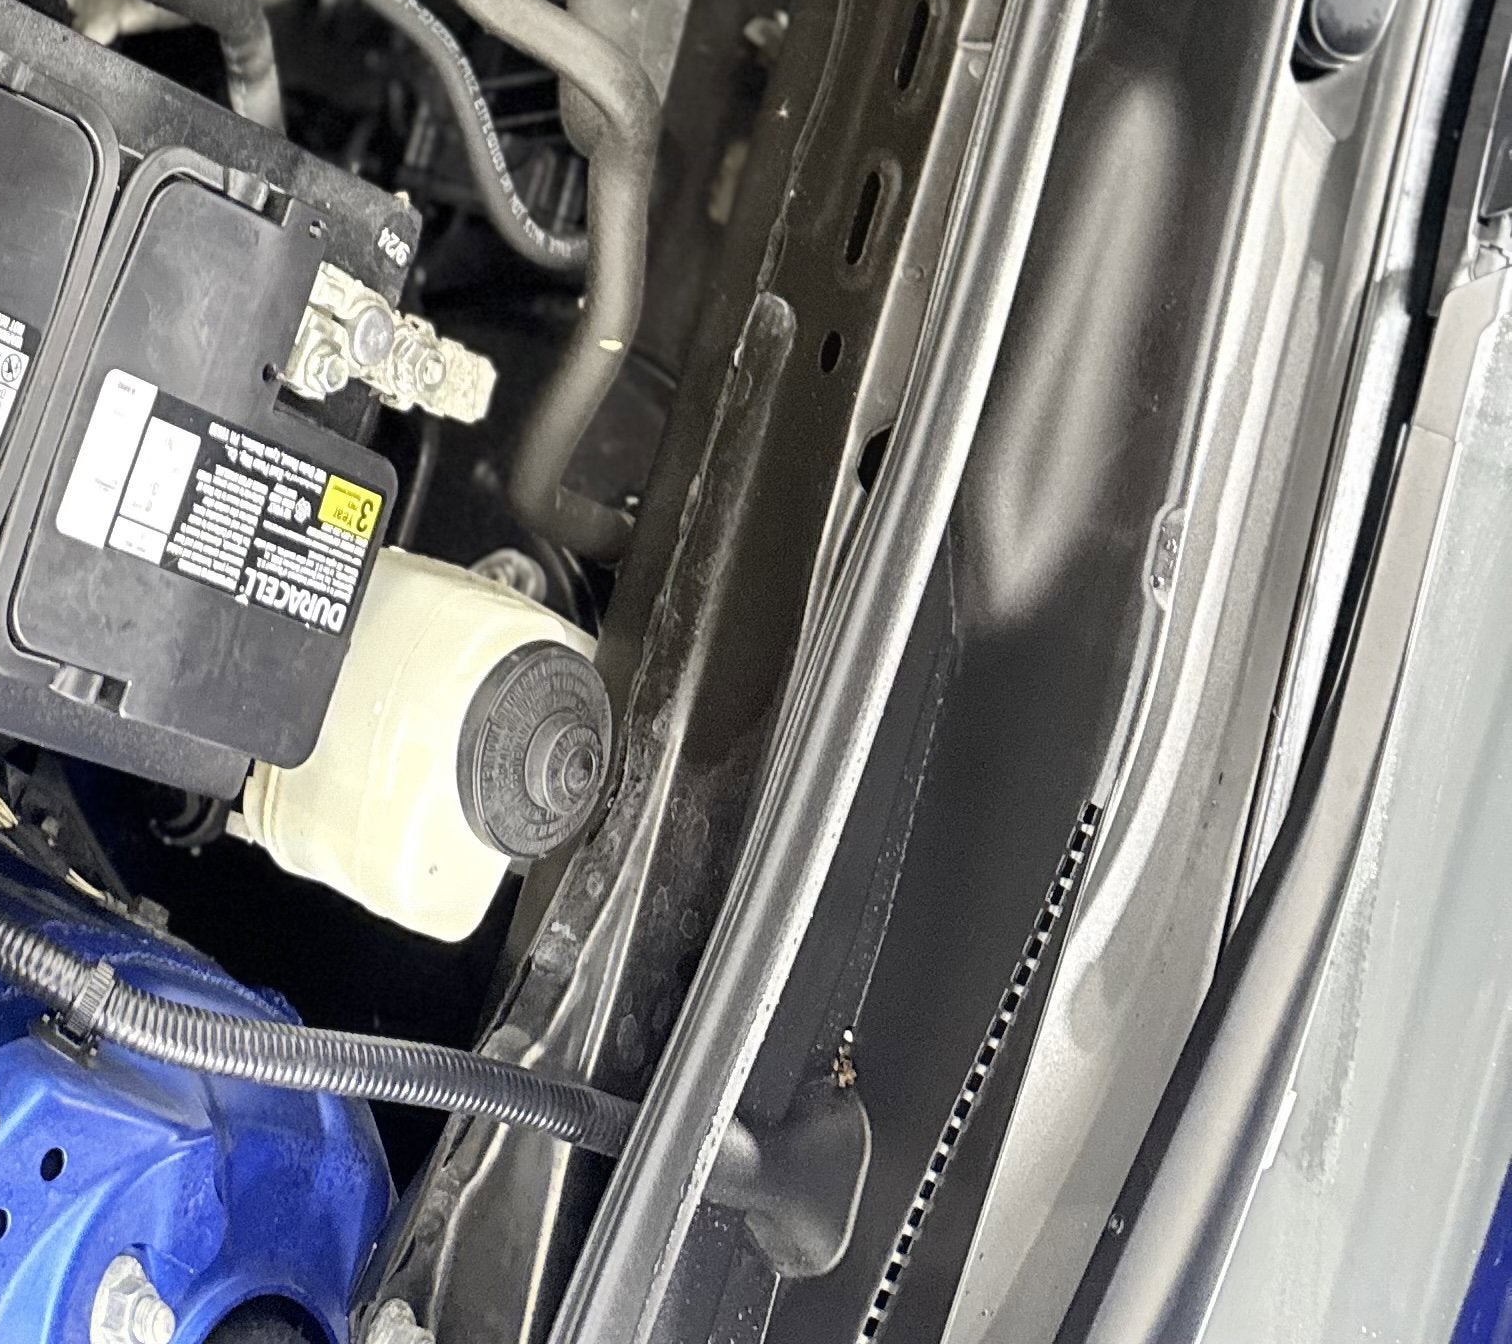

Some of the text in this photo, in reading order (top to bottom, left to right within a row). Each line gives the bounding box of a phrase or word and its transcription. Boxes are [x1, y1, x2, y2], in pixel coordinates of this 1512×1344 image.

[330, 506, 356, 528] Year
[352, 497, 376, 534] 3
[236, 564, 349, 633] DURACELL
